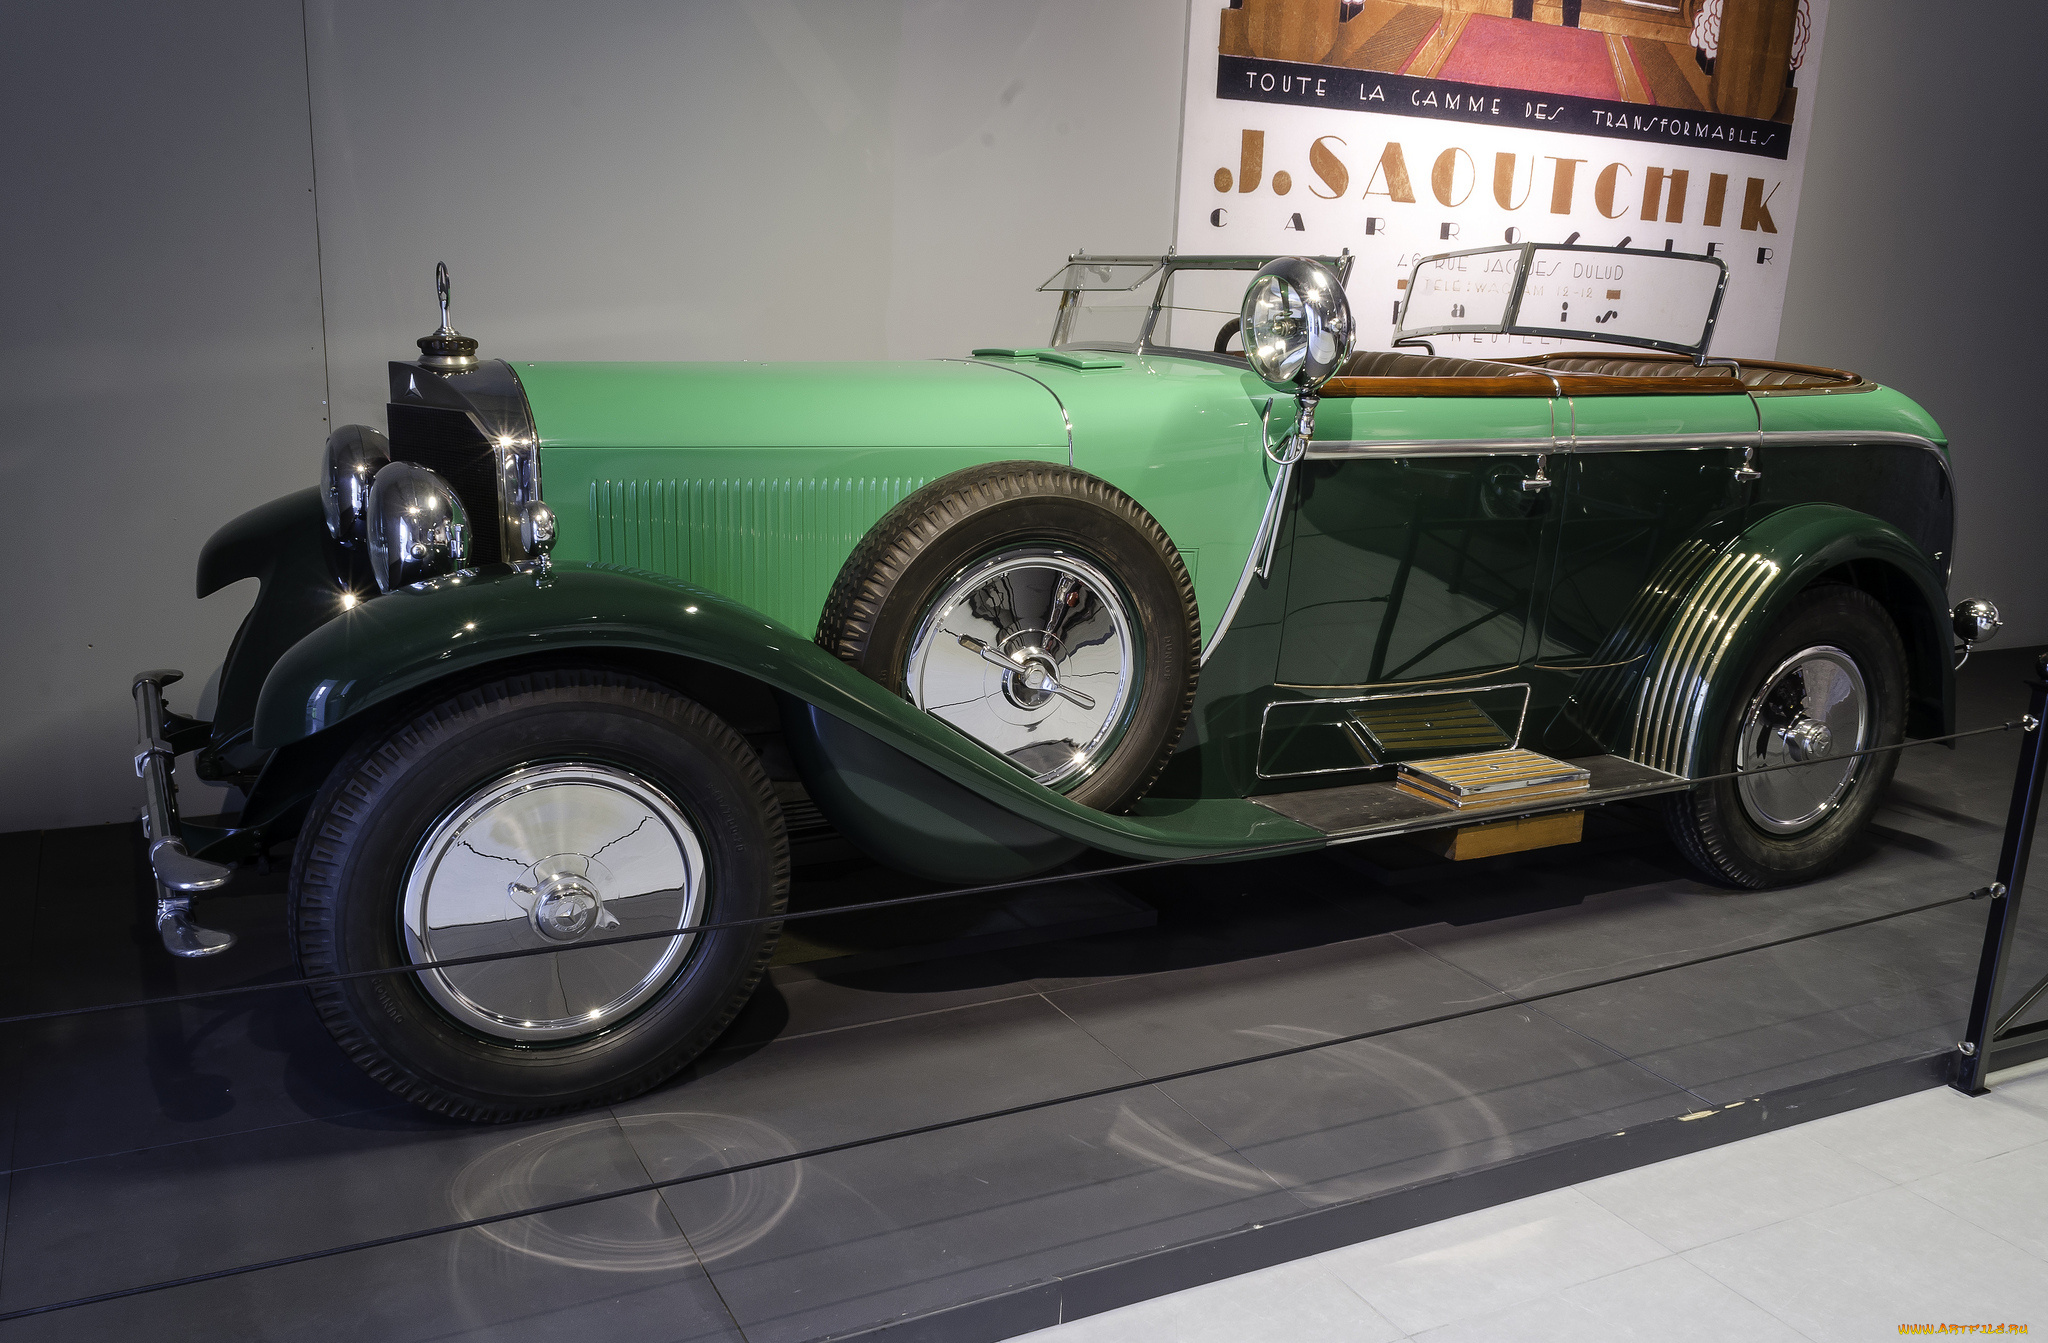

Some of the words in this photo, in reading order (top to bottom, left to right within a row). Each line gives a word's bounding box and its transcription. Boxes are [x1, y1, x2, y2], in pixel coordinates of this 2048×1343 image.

[1246, 71, 1326, 97] TOUTE
[1360, 83, 1386, 102] LA
[1411, 89, 1501, 115] GAMME
[1525, 101, 1564, 121] DES
[1592, 110, 1775, 146] TRANSFORMABLES
[1573, 262, 1624, 281] DULUD
